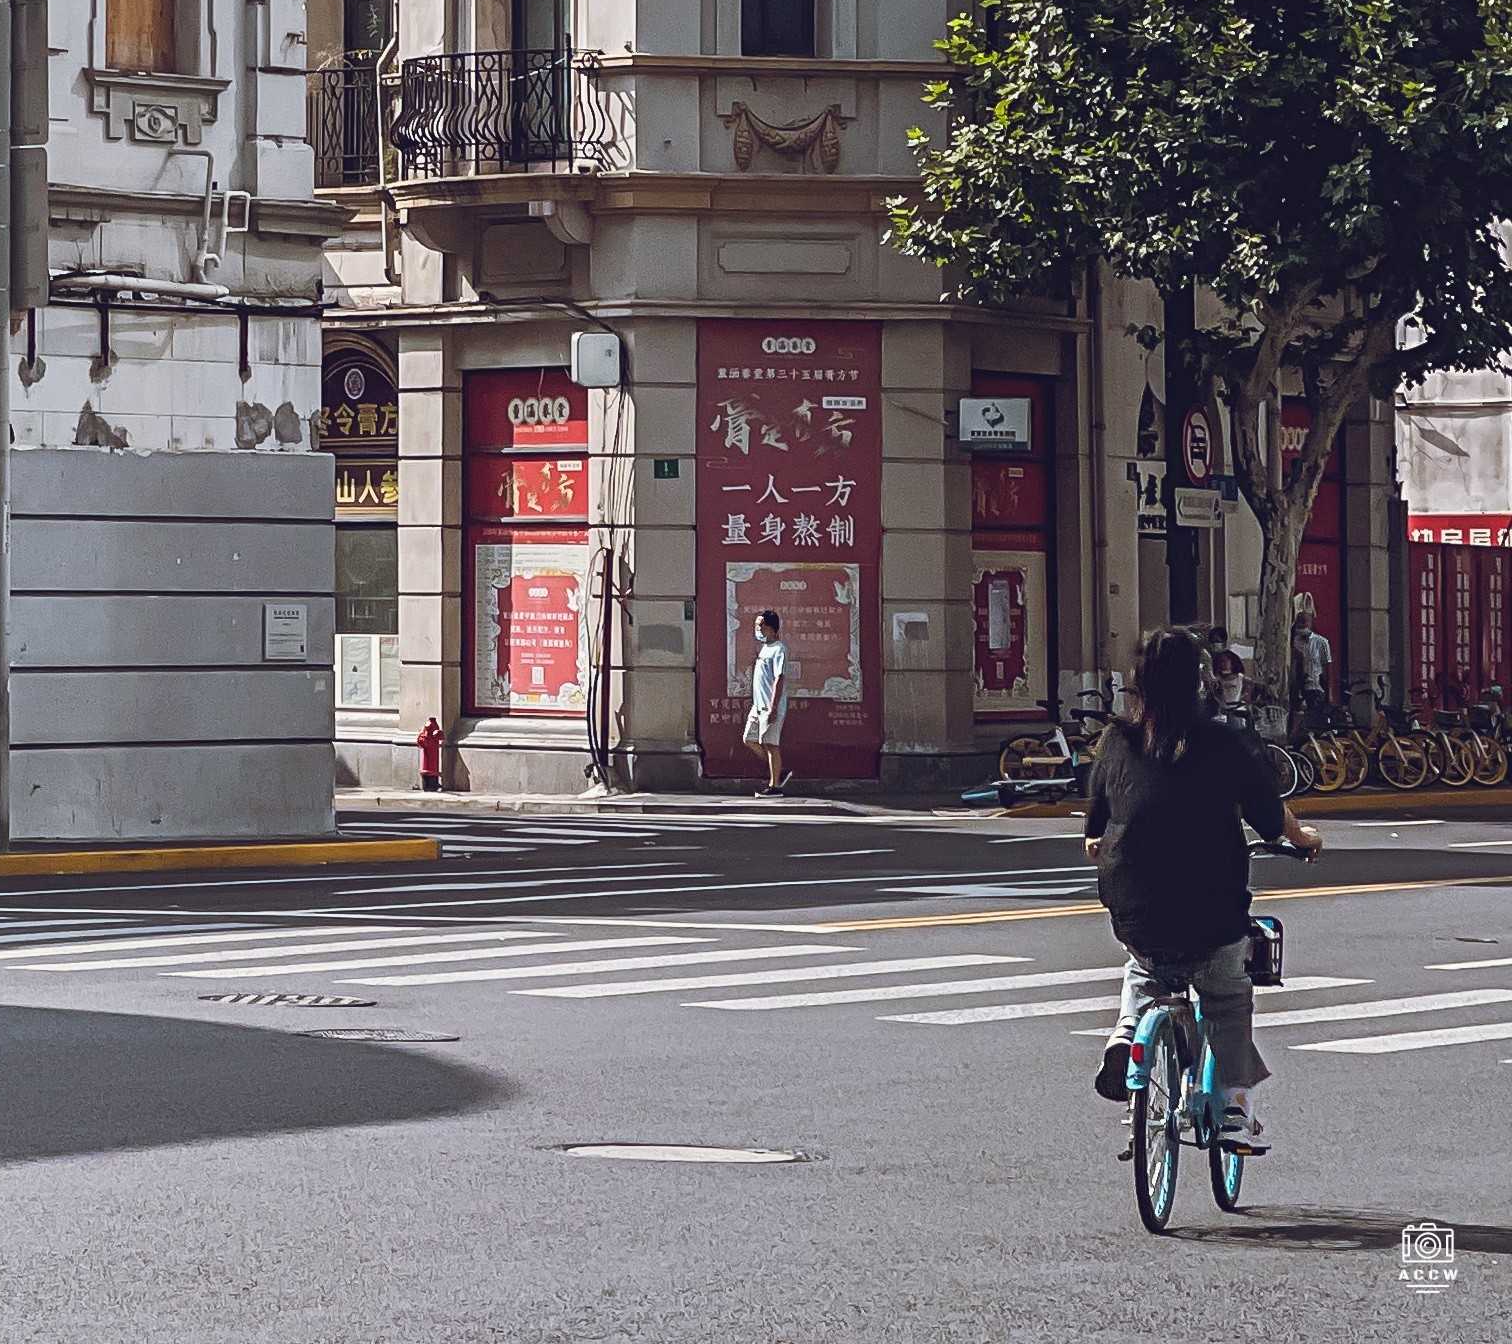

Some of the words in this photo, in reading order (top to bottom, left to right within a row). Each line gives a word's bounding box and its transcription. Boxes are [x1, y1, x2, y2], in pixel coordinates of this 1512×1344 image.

[721, 473, 857, 507] 一人一方
[721, 513, 855, 547] 量身熬制
